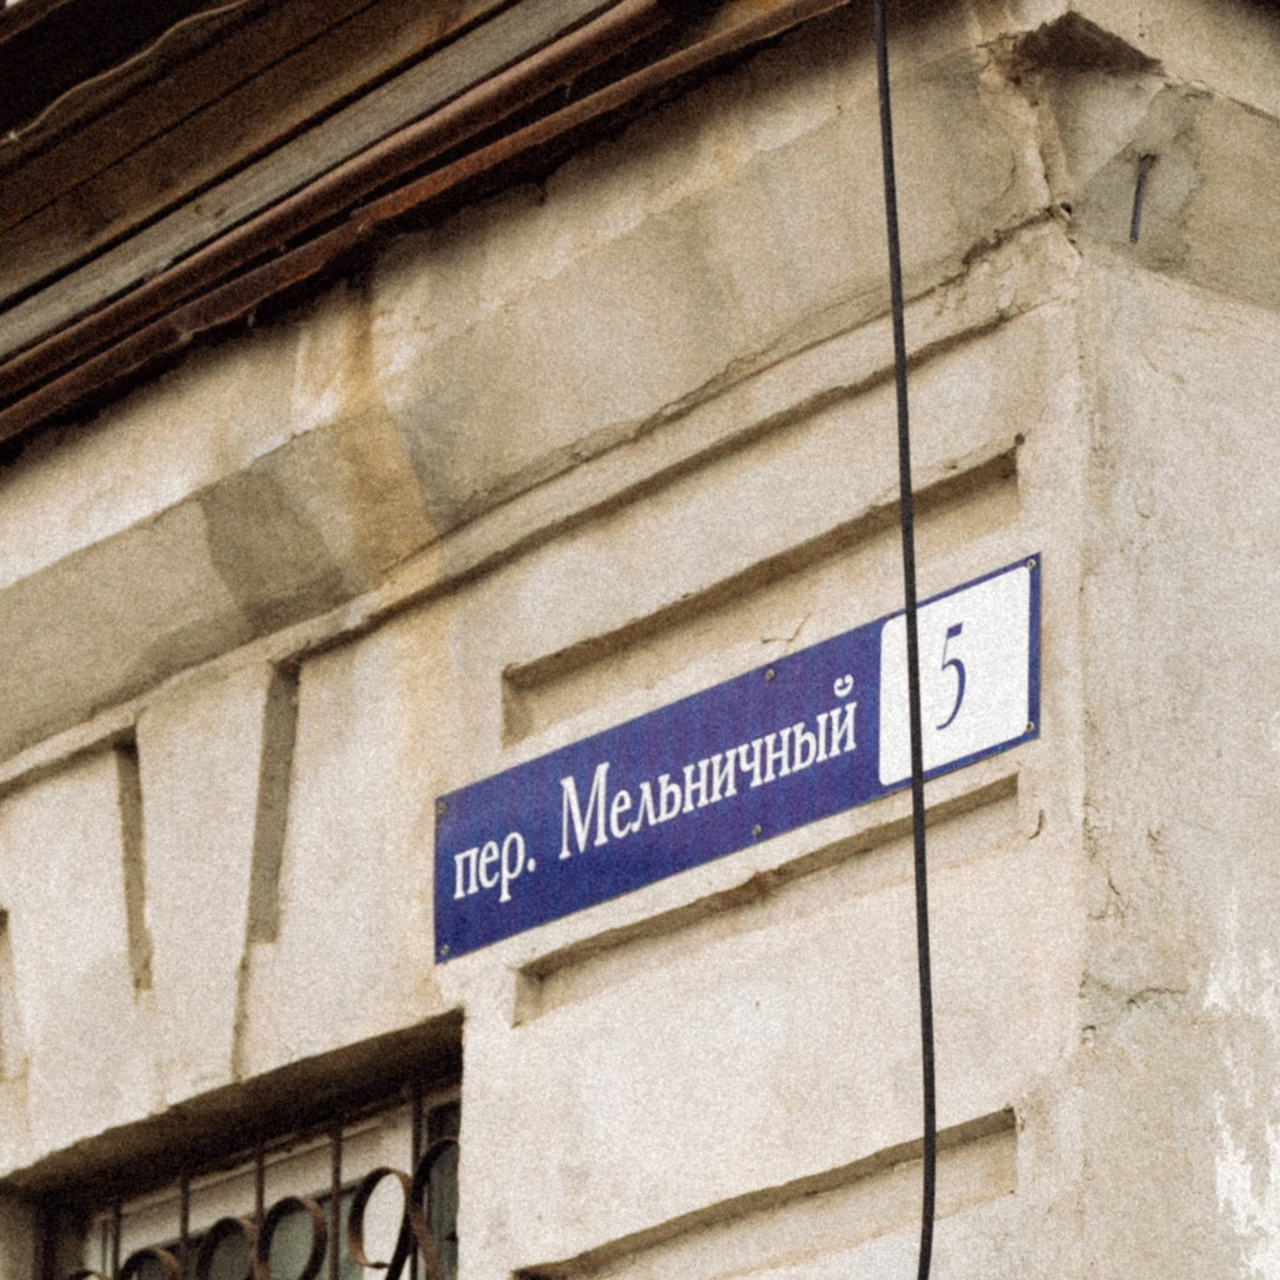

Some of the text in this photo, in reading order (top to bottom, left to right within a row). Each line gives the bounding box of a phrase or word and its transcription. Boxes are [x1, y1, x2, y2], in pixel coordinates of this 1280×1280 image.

[453, 622, 967, 903] пер. Мельничный 5
